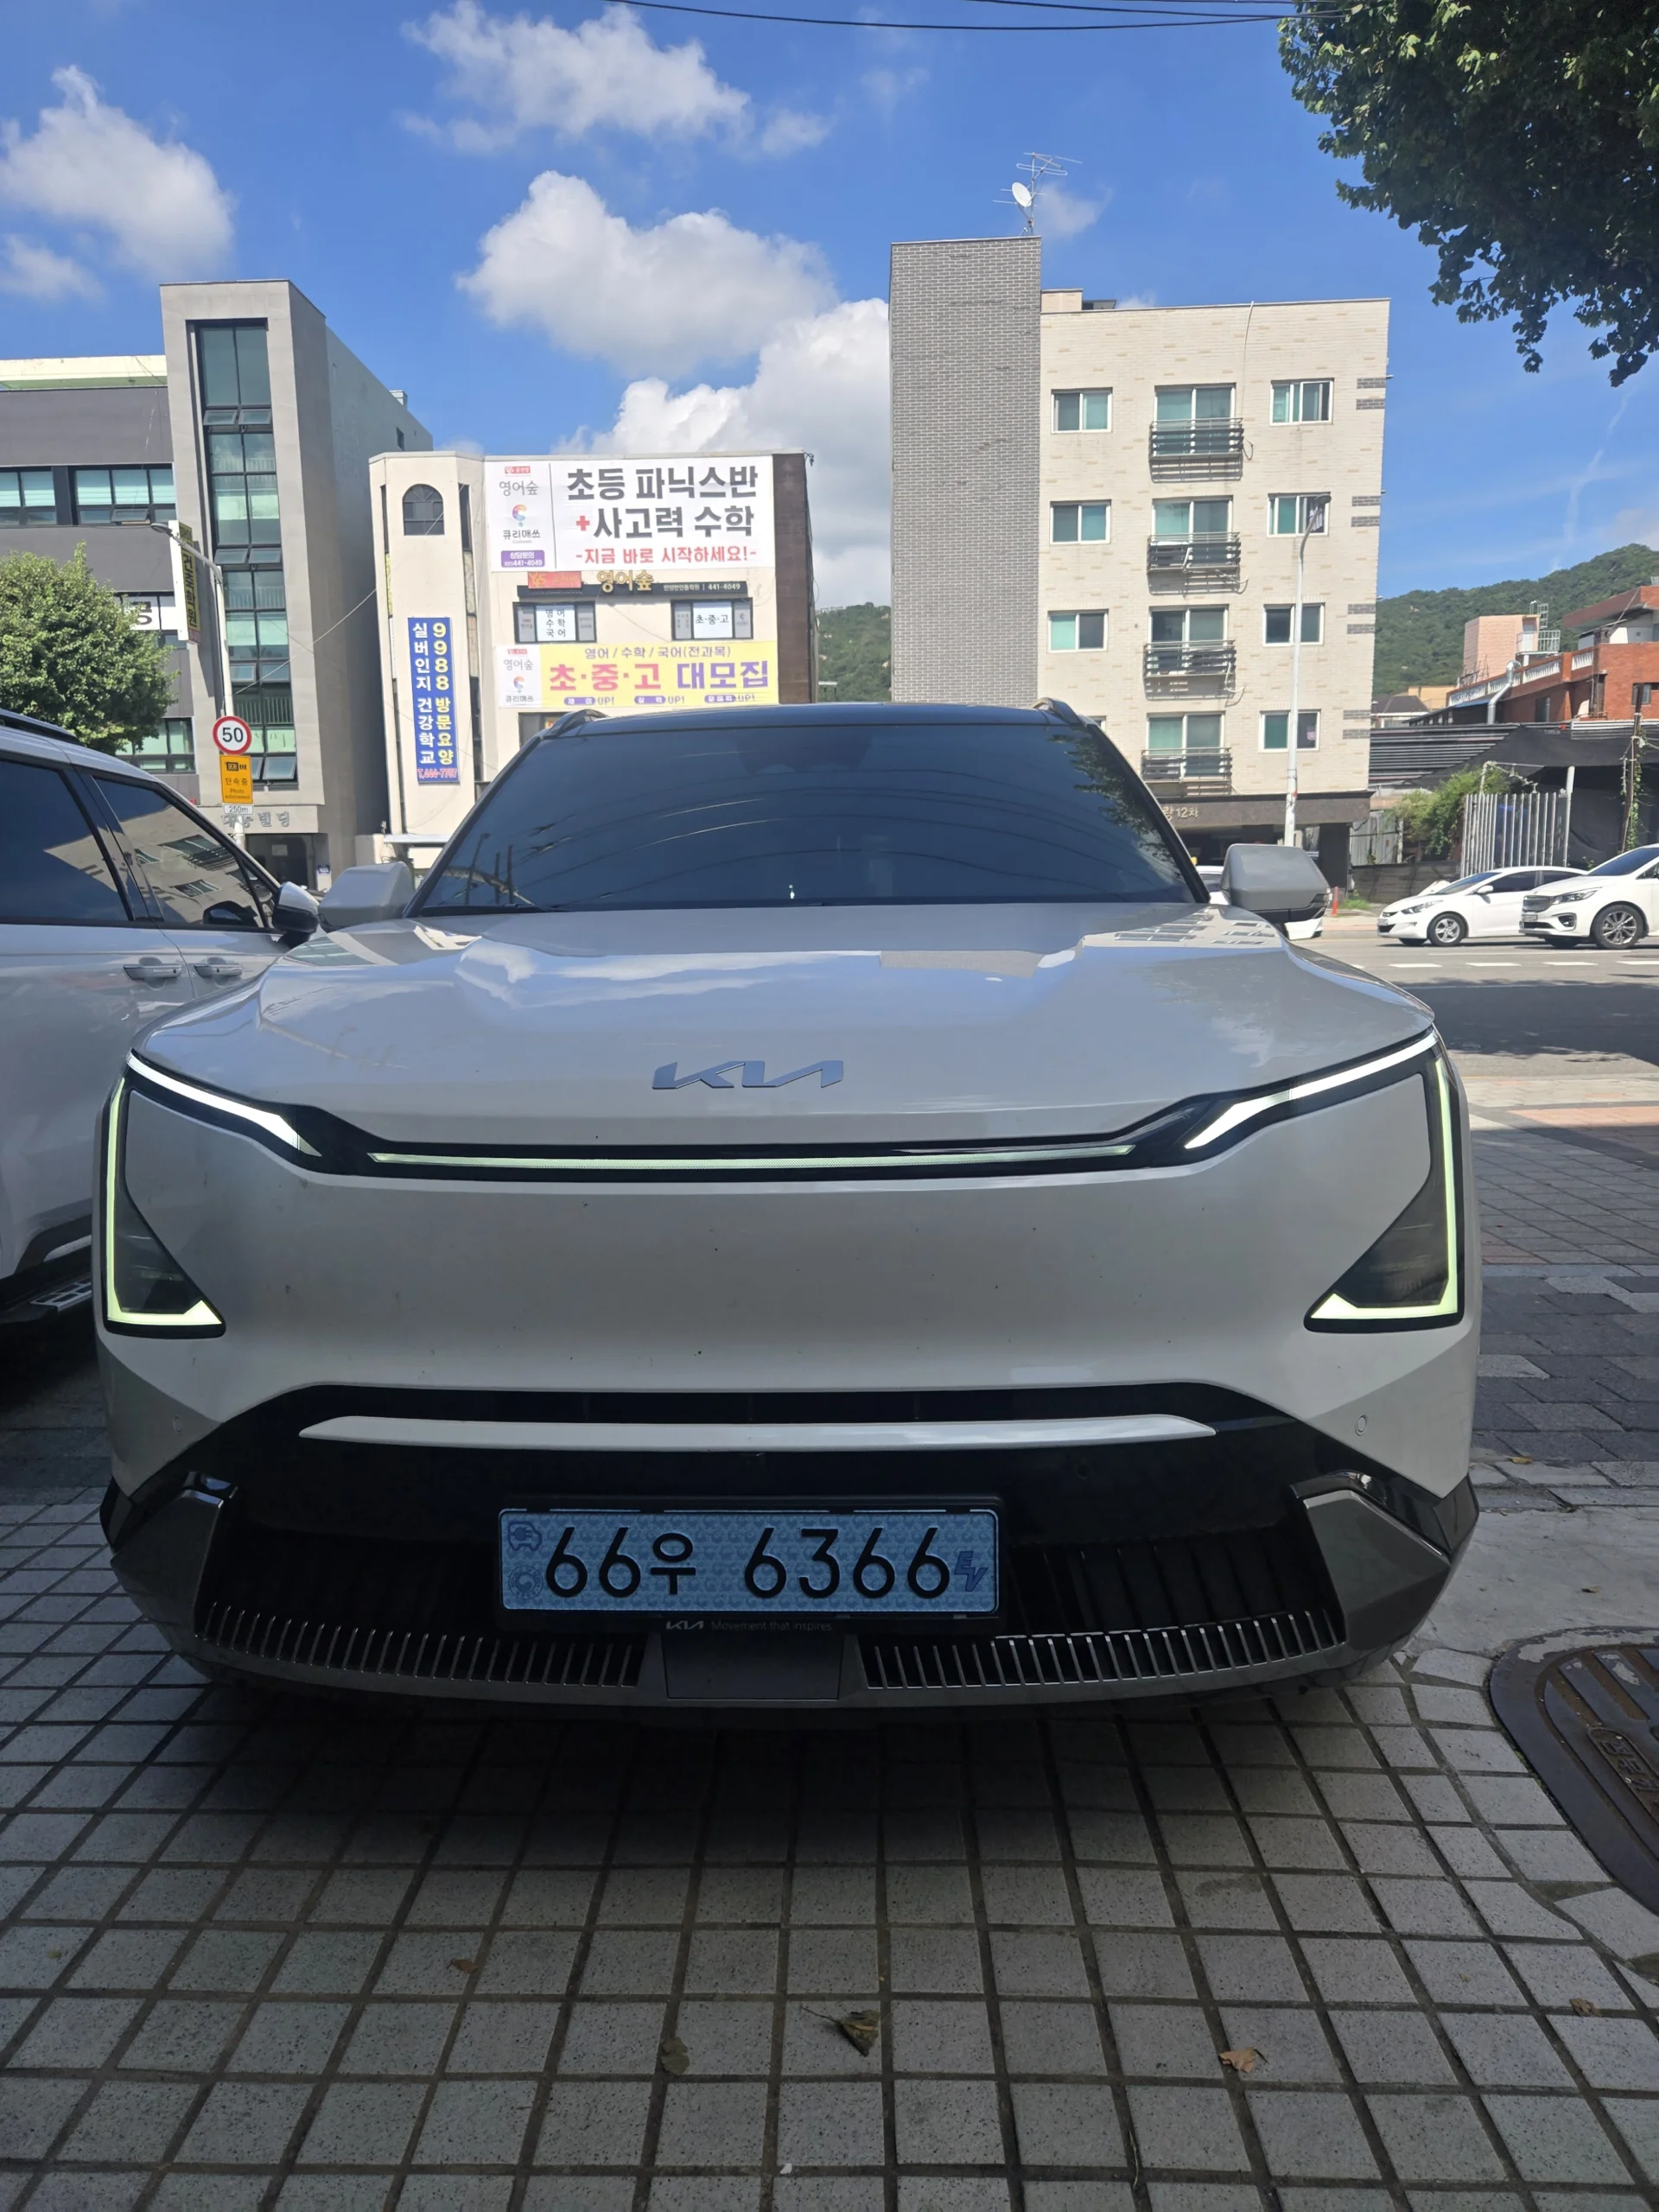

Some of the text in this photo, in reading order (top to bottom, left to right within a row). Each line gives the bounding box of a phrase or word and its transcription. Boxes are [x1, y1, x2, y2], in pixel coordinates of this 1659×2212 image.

[499, 480, 539, 497] 영어숲
[567, 465, 759, 500] 초등 파닉스반
[694, 505, 754, 537] 수학
[503, 529, 540, 540] 큐리매쓰
[623, 548, 654, 564] 바로
[597, 570, 654, 593] 영어숲
[545, 619, 566, 628] 수학
[695, 614, 729, 625] 초·중·고
[545, 628, 566, 638] 국어
[585, 647, 610, 659] 영어
[621, 647, 646, 658] 수학
[658, 645, 731, 658] 국어(전과목)
[504, 659, 534, 671] 영어숲
[550, 660, 768, 691] 초·중·고 대모집
[412, 622, 436, 765] 실버인지 건강학교
[432, 622, 454, 766] 9988 방문요양
[505, 695, 535, 703] 큐리매쓰
[597, 696, 614, 705] UP!
[667, 695, 684, 704] UP!
[222, 728, 244, 742] 50
[229, 805, 249, 814] 250m
[545, 1526, 696, 1599] 66우
[744, 1527, 950, 1599] 6366
[954, 1551, 988, 1592] EV
[666, 1621, 833, 1633] KIA Movement that inspires
